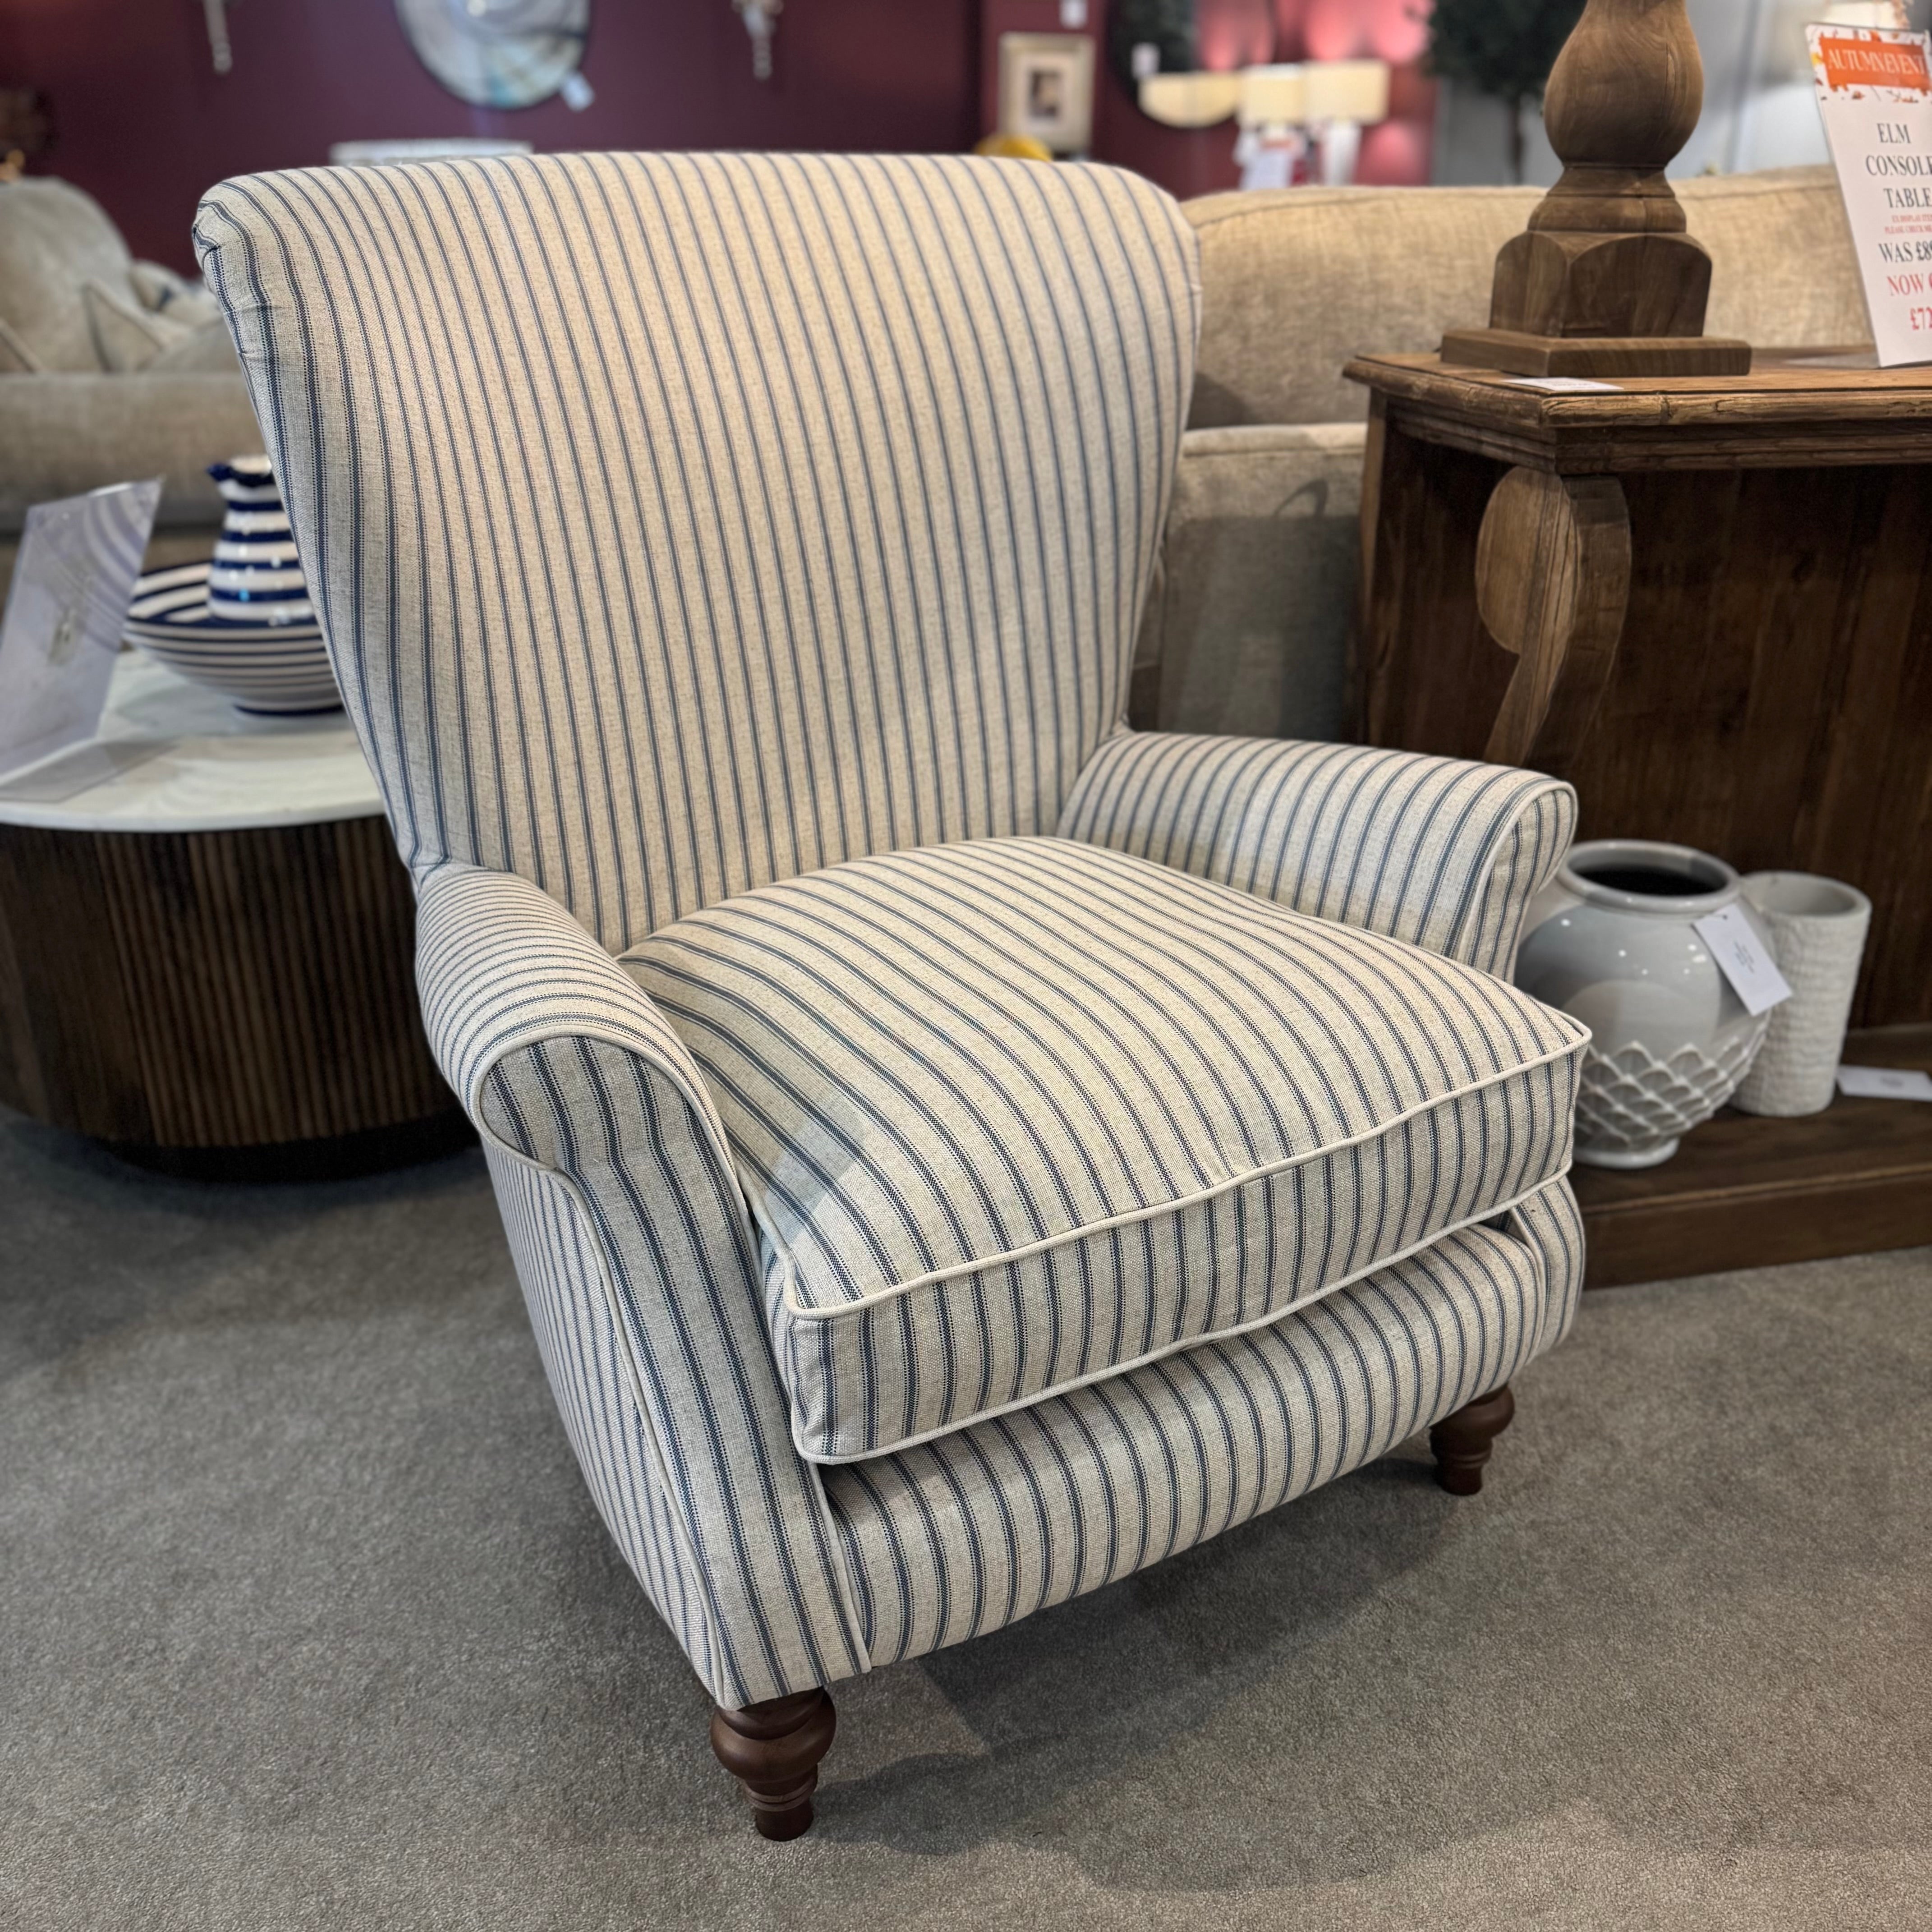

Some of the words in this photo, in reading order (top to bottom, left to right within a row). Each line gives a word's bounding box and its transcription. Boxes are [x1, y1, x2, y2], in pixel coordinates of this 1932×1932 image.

[1828, 48, 1885, 72] AUTUMN
[1882, 52, 1925, 75] EVENT
[1877, 123, 1912, 144] ELM
[1882, 187, 1932, 208] TABLE
[1877, 241, 1914, 263] WAS
[1886, 273, 1924, 296] NOW
